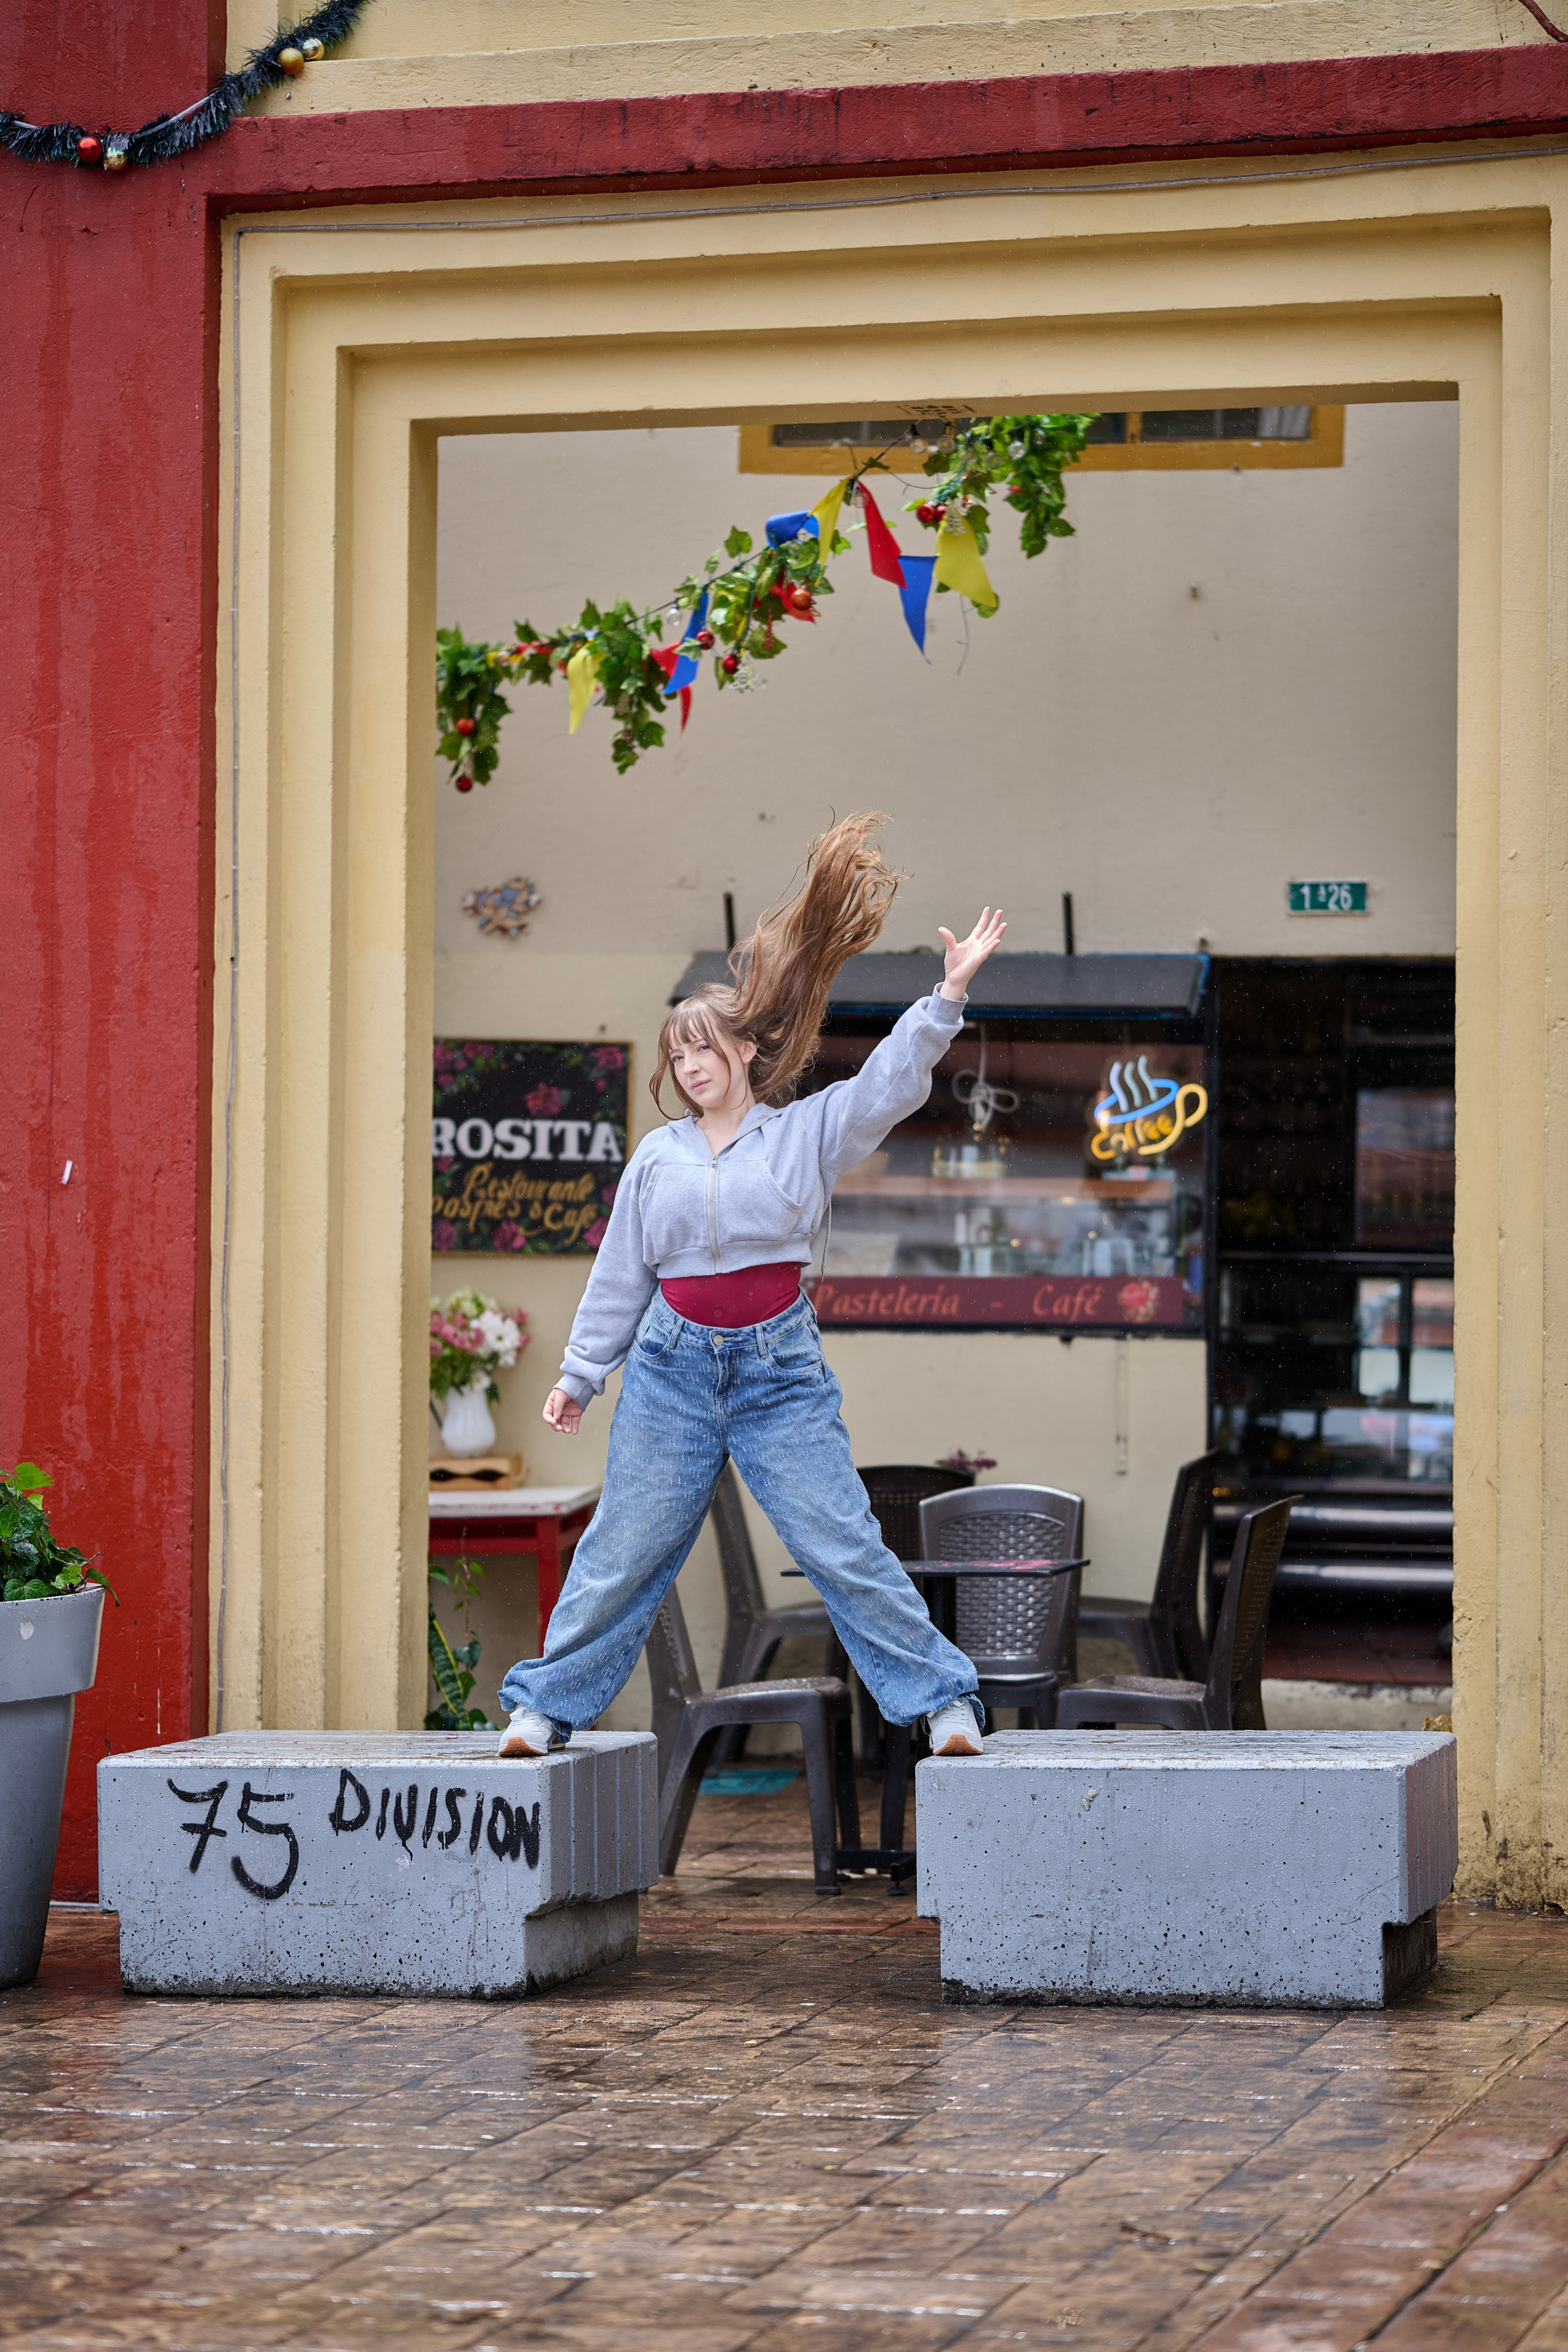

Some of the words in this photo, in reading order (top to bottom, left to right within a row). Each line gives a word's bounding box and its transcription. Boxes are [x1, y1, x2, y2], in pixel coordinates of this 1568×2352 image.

[432, 1117, 624, 1162] ROSITA
[1033, 1283, 1102, 1323] Café
[167, 1778, 299, 1899] 75
[330, 1768, 541, 1869] DIVISION
